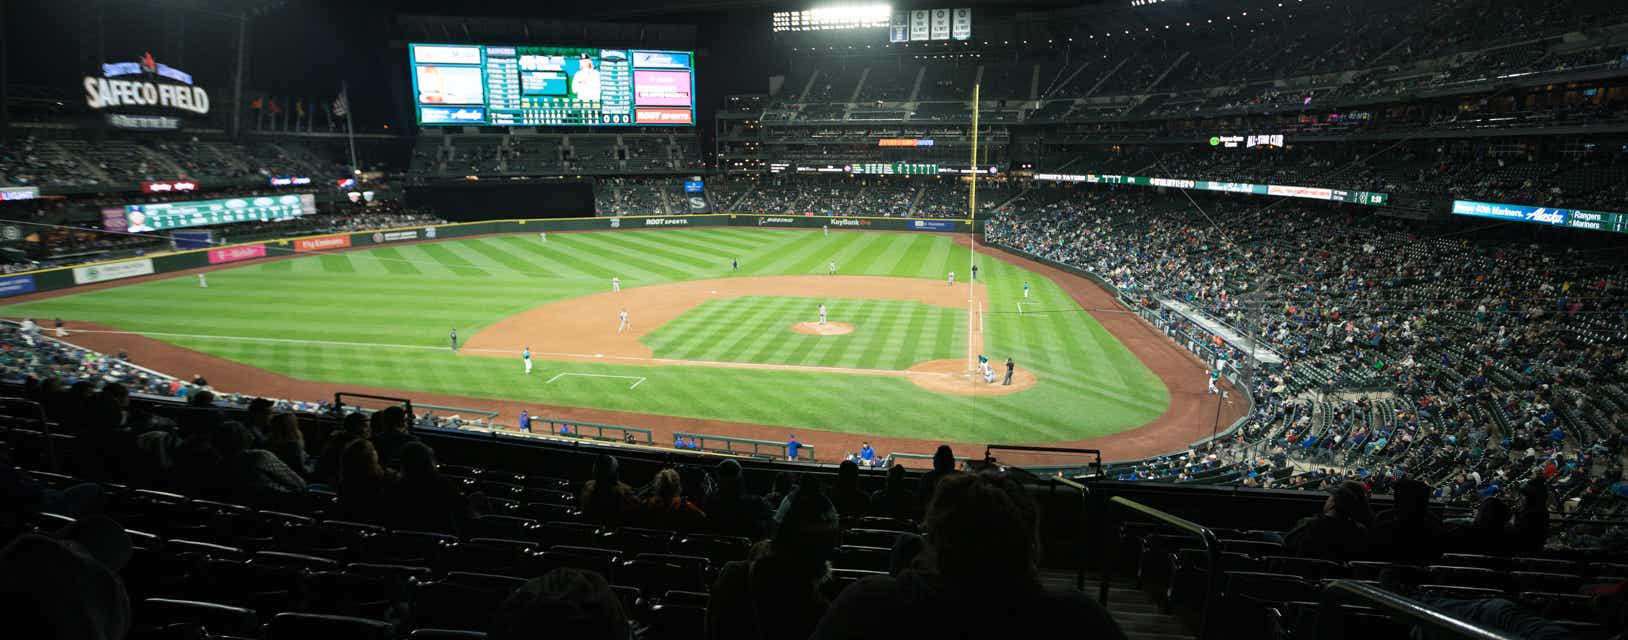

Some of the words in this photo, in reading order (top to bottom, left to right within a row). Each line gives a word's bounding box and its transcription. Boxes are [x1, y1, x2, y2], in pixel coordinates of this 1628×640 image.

[84, 76, 157, 109] SAFECO
[158, 83, 209, 114] FIELD
[603, 114, 610, 123] 0
[613, 114, 620, 123] 0
[622, 114, 629, 123] 0
[1574, 210, 1601, 221] Rangers
[1572, 220, 1600, 229] Mariners
